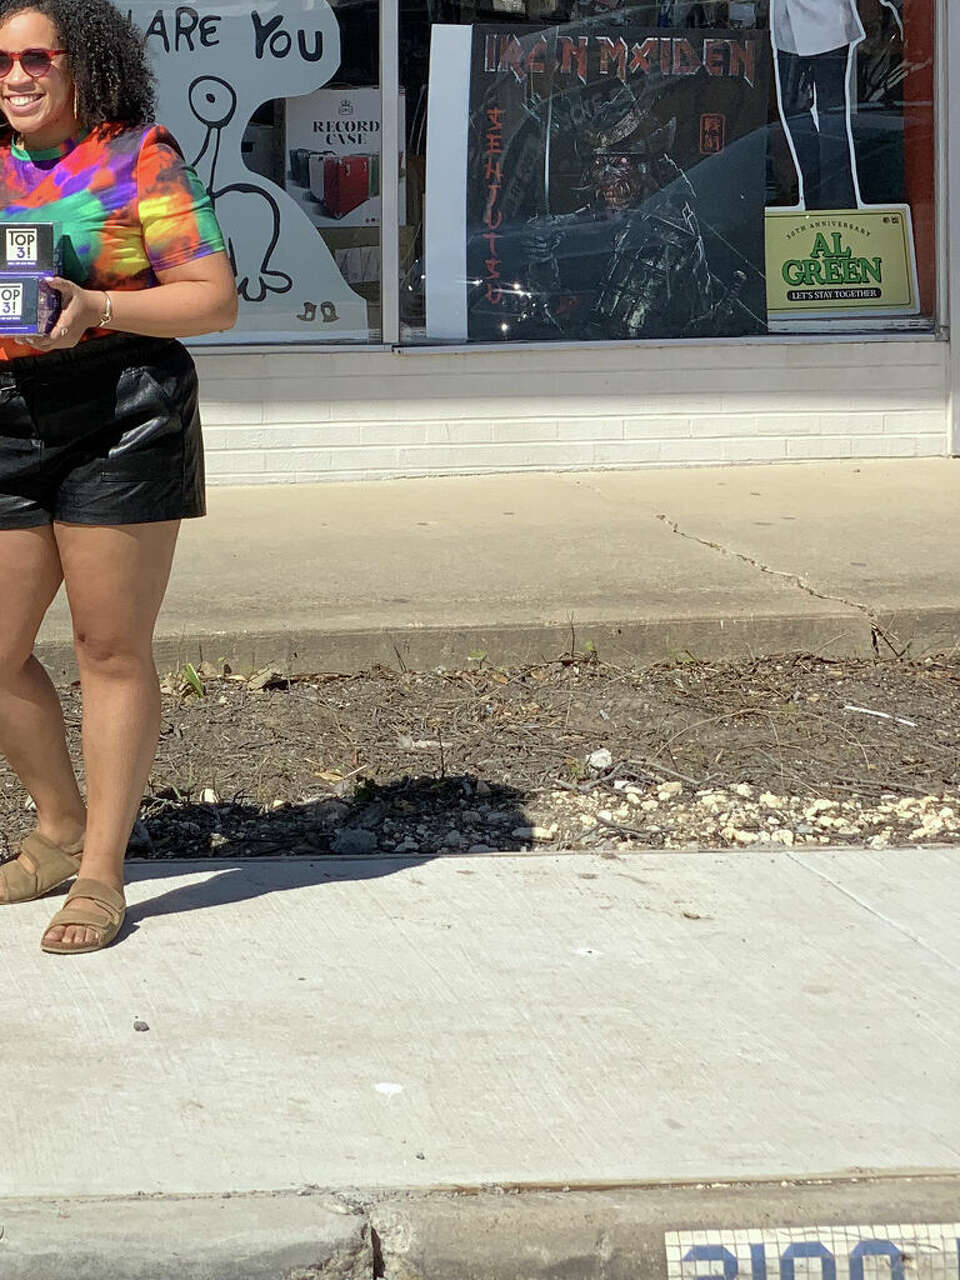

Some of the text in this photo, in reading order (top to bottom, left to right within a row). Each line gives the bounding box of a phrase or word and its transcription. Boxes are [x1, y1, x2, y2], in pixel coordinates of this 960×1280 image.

[145, 6, 324, 62] ARE YOU
[312, 120, 380, 132] RECORD
[326, 133, 368, 145] CASE
[809, 220, 872, 237] ANNIVERSARY
[8, 230, 35, 246] TOP
[810, 231, 852, 259] AL
[782, 257, 882, 287] GREEN
[791, 289, 878, 300] LET'S STAY TOGETHER
